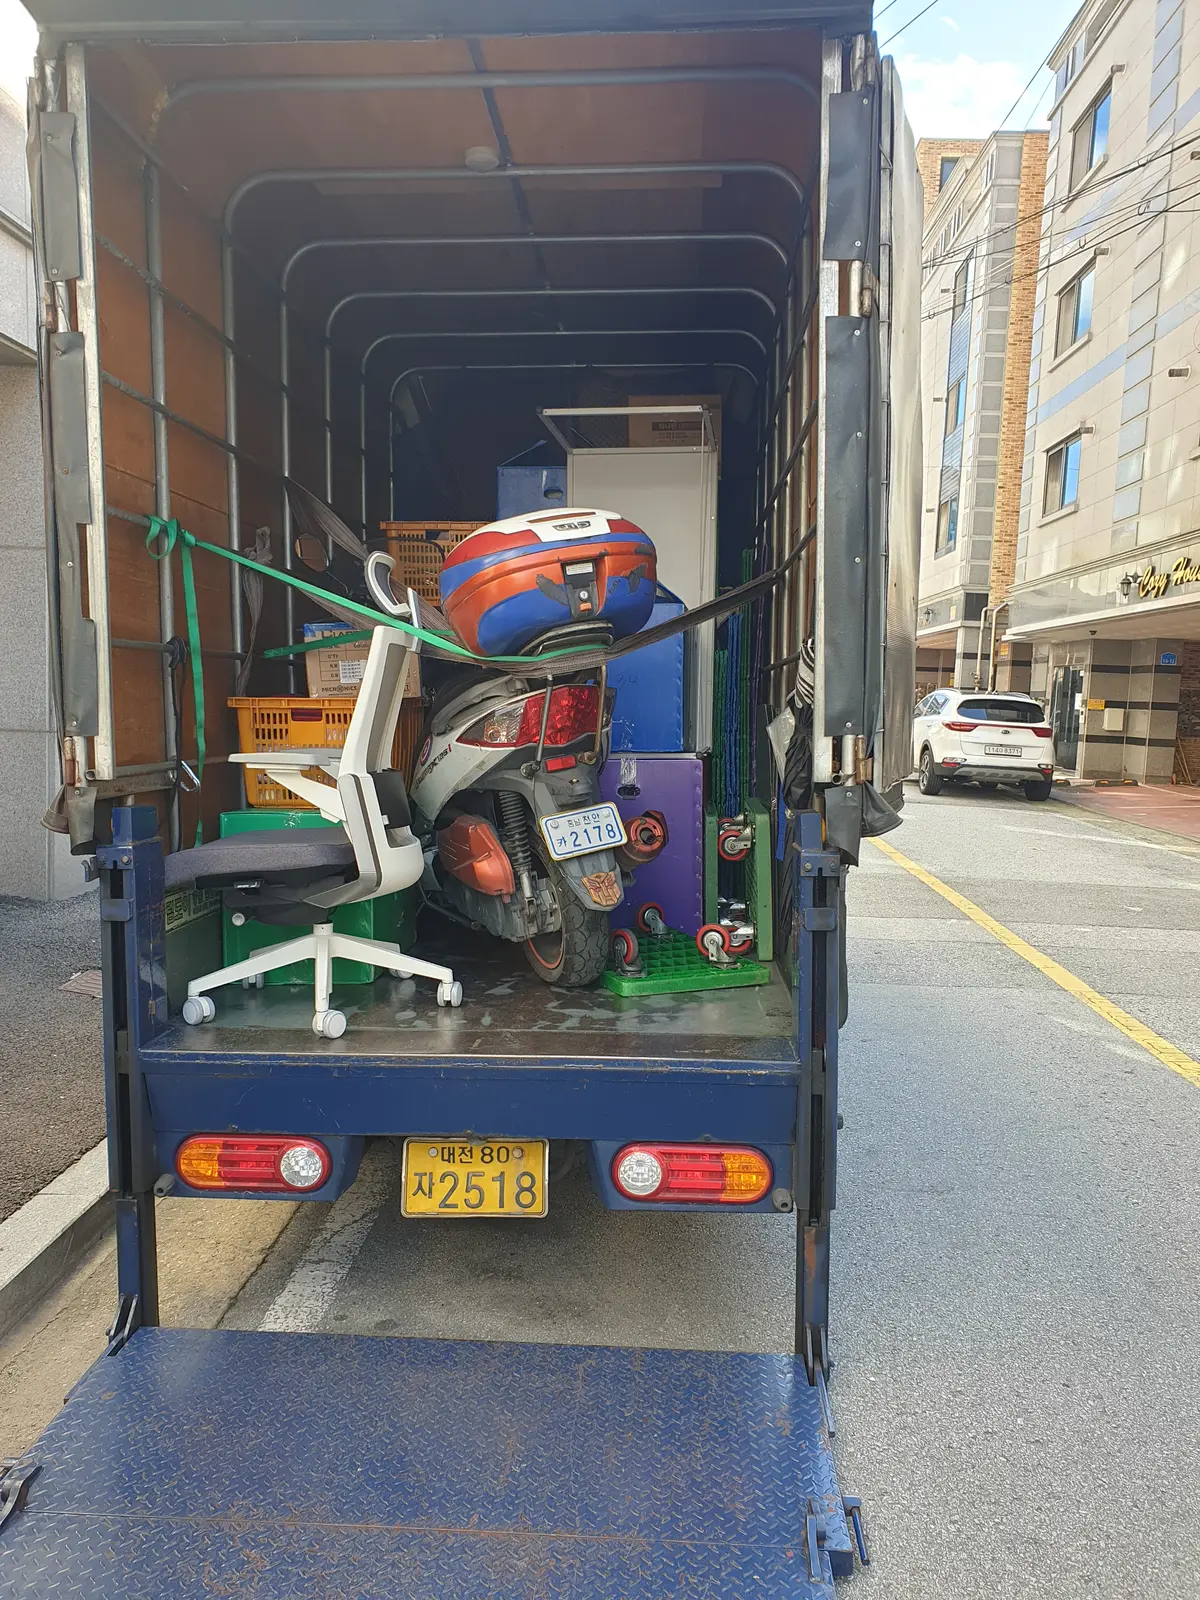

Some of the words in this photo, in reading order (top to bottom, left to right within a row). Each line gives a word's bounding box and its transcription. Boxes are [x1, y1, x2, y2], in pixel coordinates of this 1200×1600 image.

[1138, 566, 1170, 598] Cozy
[440, 1146, 474, 1164] 대전
[480, 1146, 510, 1164] 80
